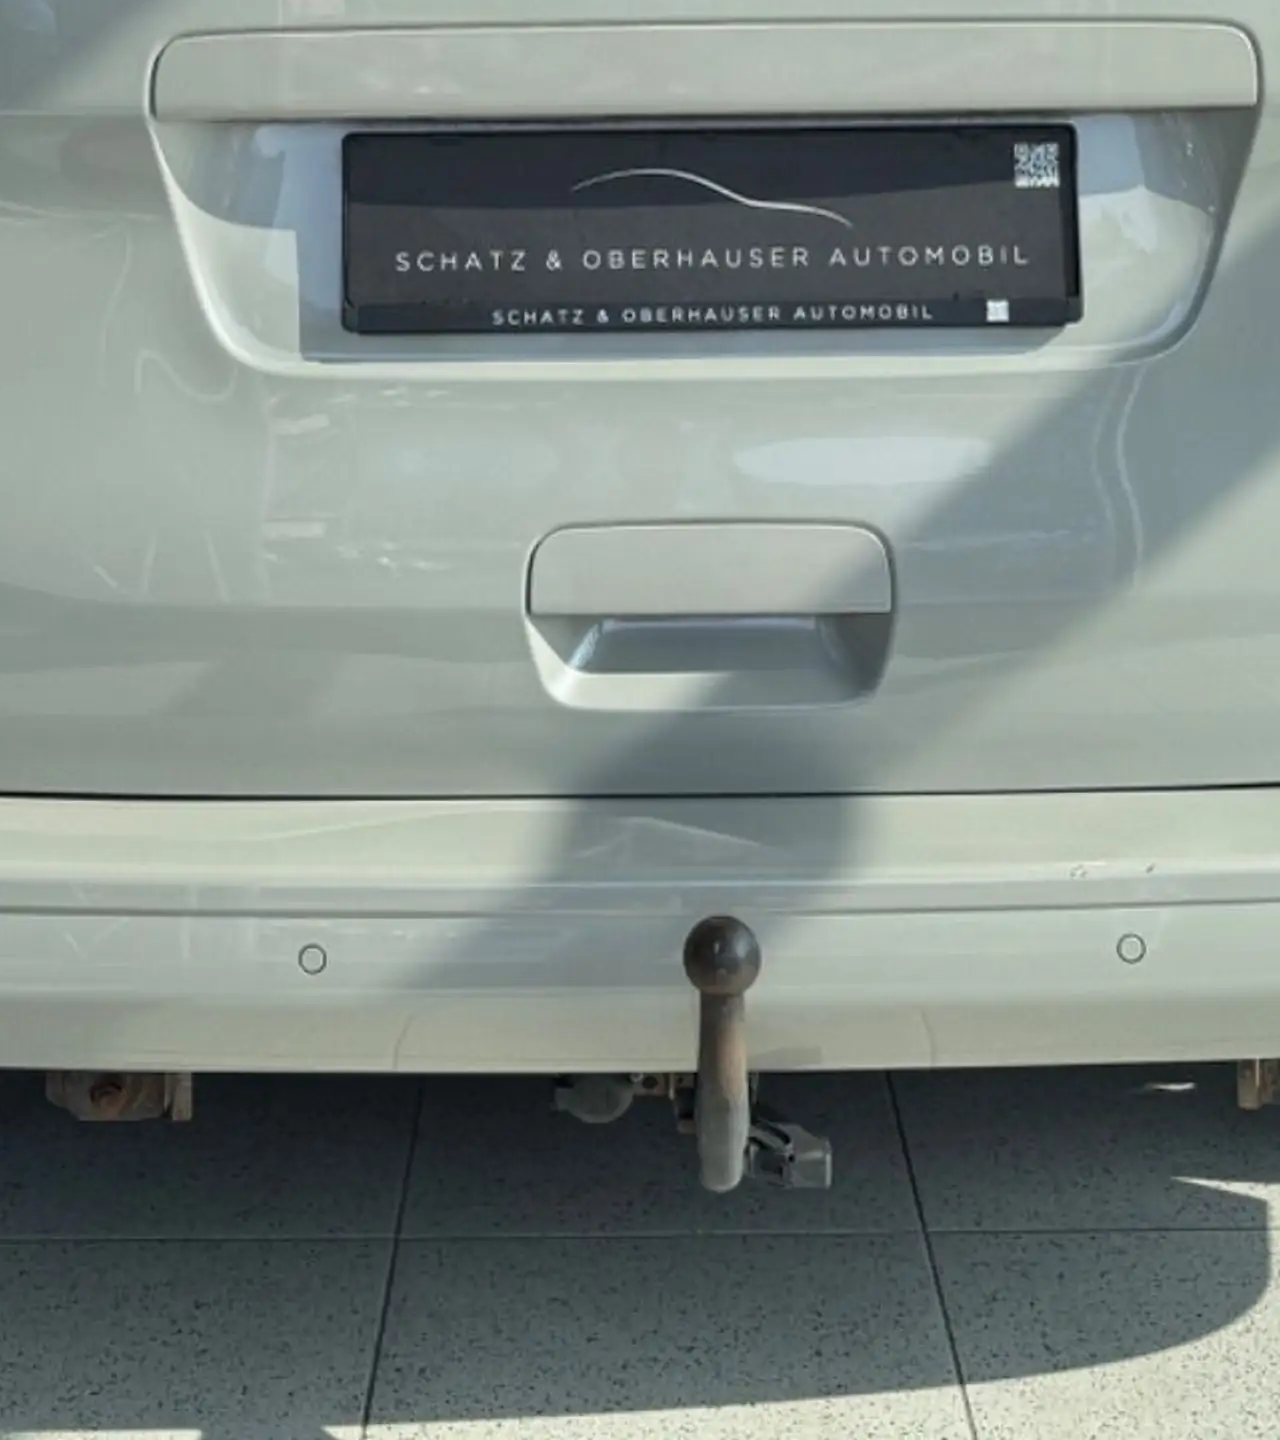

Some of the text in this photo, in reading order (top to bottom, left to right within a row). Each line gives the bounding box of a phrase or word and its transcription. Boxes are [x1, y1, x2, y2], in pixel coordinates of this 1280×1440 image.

[394, 244, 1031, 272] SCHATZ & OBERHAUSER AUTOMOBIL
[491, 304, 934, 326] SCHATZ & OBERHAUSER AUTOMOBIL
